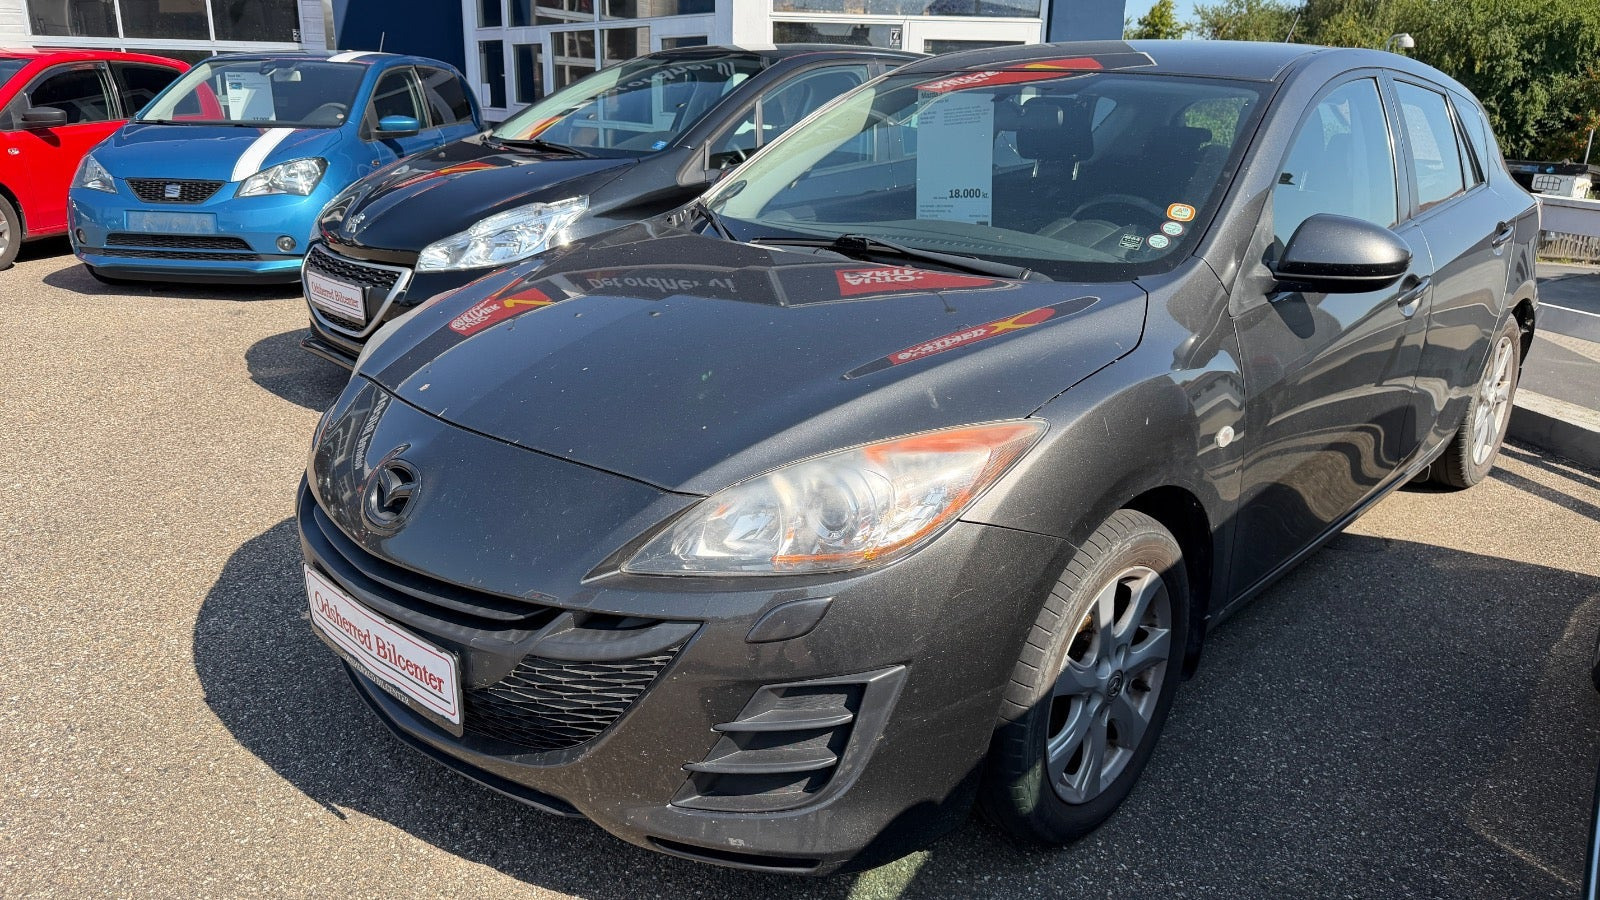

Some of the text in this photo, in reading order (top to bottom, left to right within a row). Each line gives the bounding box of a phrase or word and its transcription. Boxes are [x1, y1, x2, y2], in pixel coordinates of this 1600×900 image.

[948, 188, 981, 199] 18.000
[314, 590, 372, 652] Odsherred
[374, 634, 445, 694] Bilcenter
